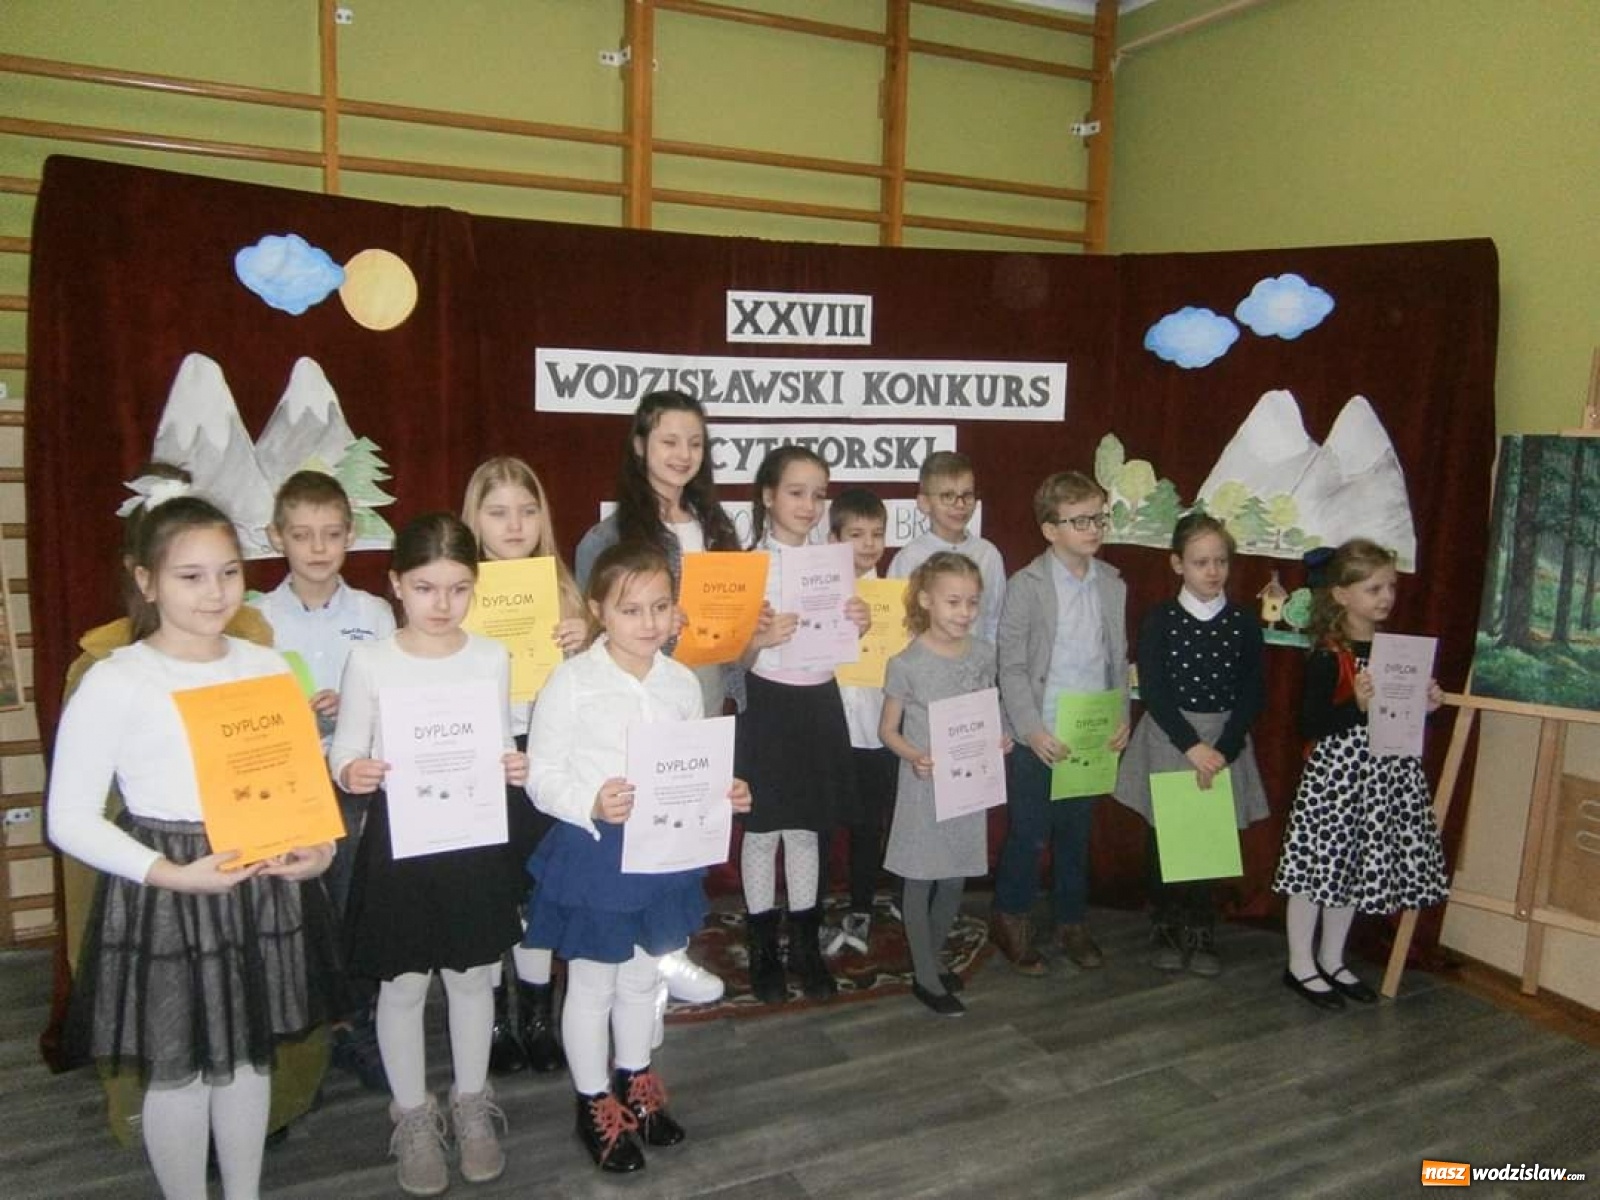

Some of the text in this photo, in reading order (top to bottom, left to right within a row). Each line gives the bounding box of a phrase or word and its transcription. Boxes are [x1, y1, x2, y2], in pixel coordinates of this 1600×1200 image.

[732, 299, 866, 337] XXVIII
[544, 361, 1050, 409] WODZISŁAWSKI KONKURS
[703, 582, 747, 594] DYPLOM
[801, 573, 841, 587] DYPLOM
[482, 593, 535, 608] DYPLOM
[220, 713, 285, 738] DYPLOM
[414, 722, 475, 740] DYPLOM
[948, 720, 985, 738] DYPLOM
[656, 757, 710, 774] DYPLOM
